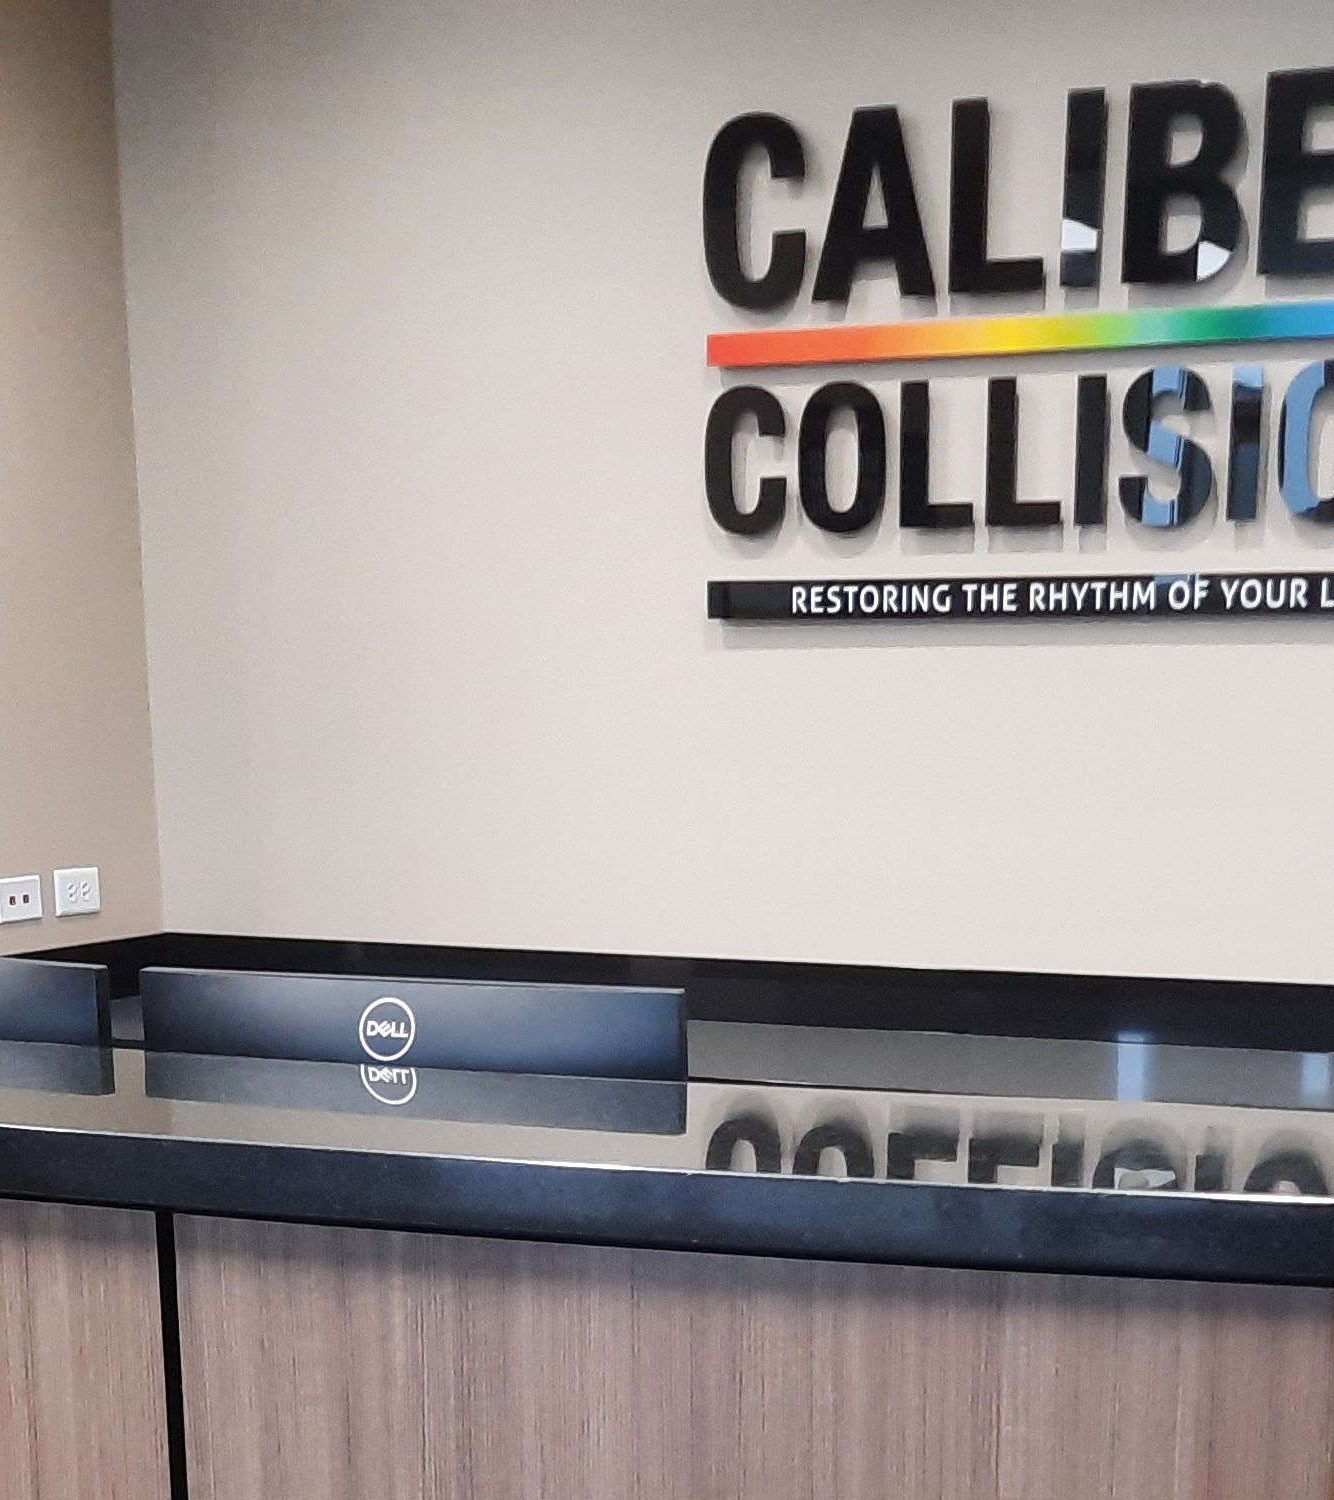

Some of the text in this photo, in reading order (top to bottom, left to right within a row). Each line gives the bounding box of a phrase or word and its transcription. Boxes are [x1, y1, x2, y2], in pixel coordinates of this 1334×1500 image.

[791, 584, 952, 615] RESTORING
[961, 583, 1018, 613] THE
[1029, 580, 1156, 612] RHYTHM
[1167, 578, 1211, 611] OF
[1220, 577, 1309, 610] YOUR
[366, 1020, 409, 1038] DELL
